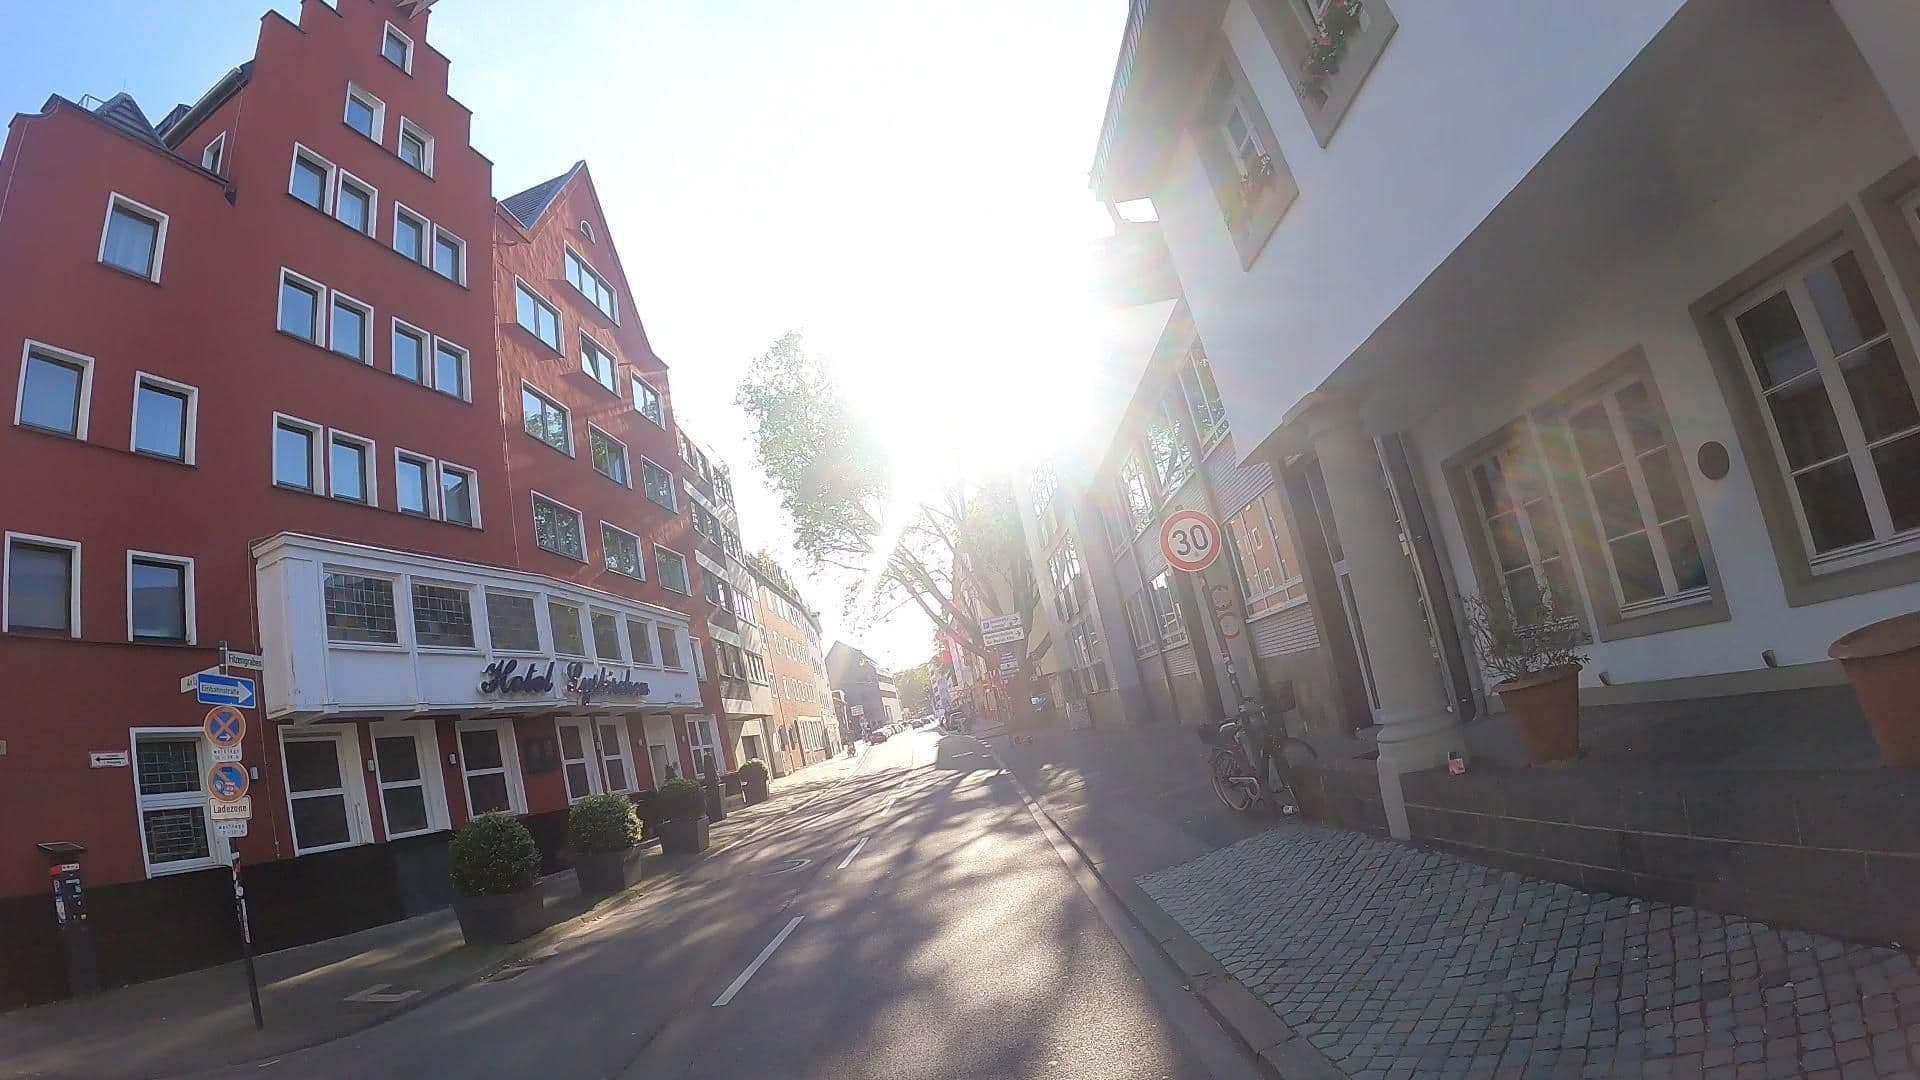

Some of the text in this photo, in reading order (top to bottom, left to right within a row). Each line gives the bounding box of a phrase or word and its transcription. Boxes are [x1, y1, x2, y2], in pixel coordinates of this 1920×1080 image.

[1172, 524, 1209, 556] 30
[481, 659, 555, 694] Hotel
[213, 804, 247, 814] Ladezone
